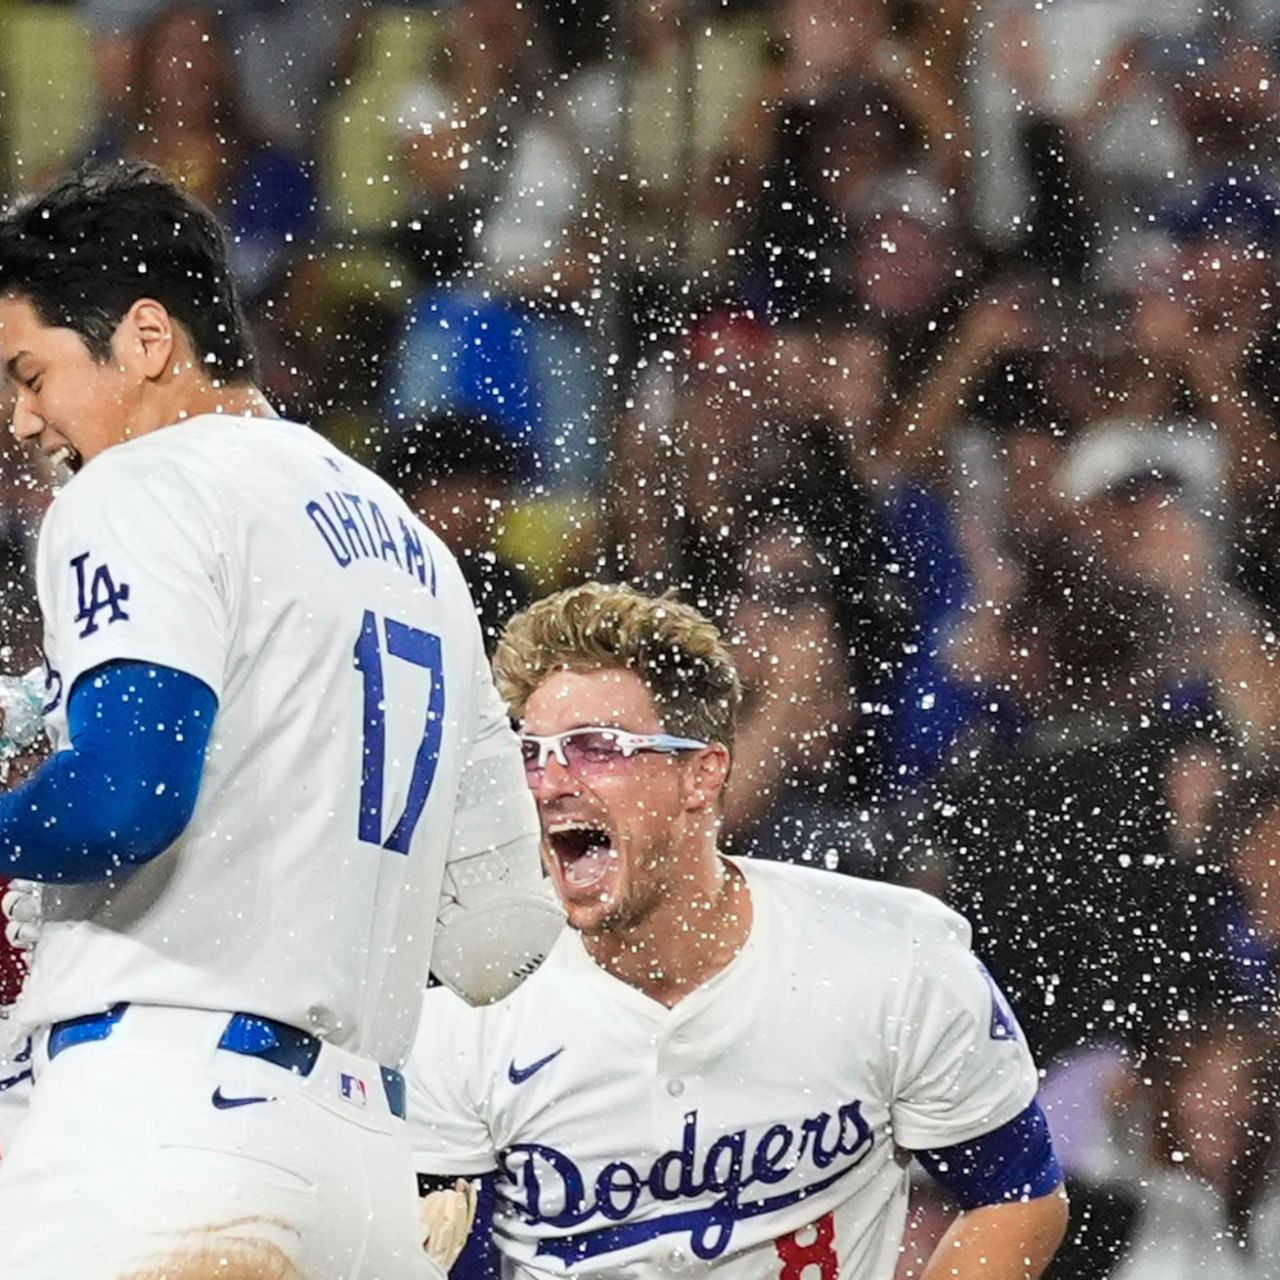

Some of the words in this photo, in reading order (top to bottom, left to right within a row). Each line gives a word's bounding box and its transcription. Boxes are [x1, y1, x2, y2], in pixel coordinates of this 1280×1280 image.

[70, 551, 130, 639] LA
[304, 490, 437, 599] OHTANI
[352, 608, 446, 856] 17
[497, 1098, 875, 1268] Dodgers
